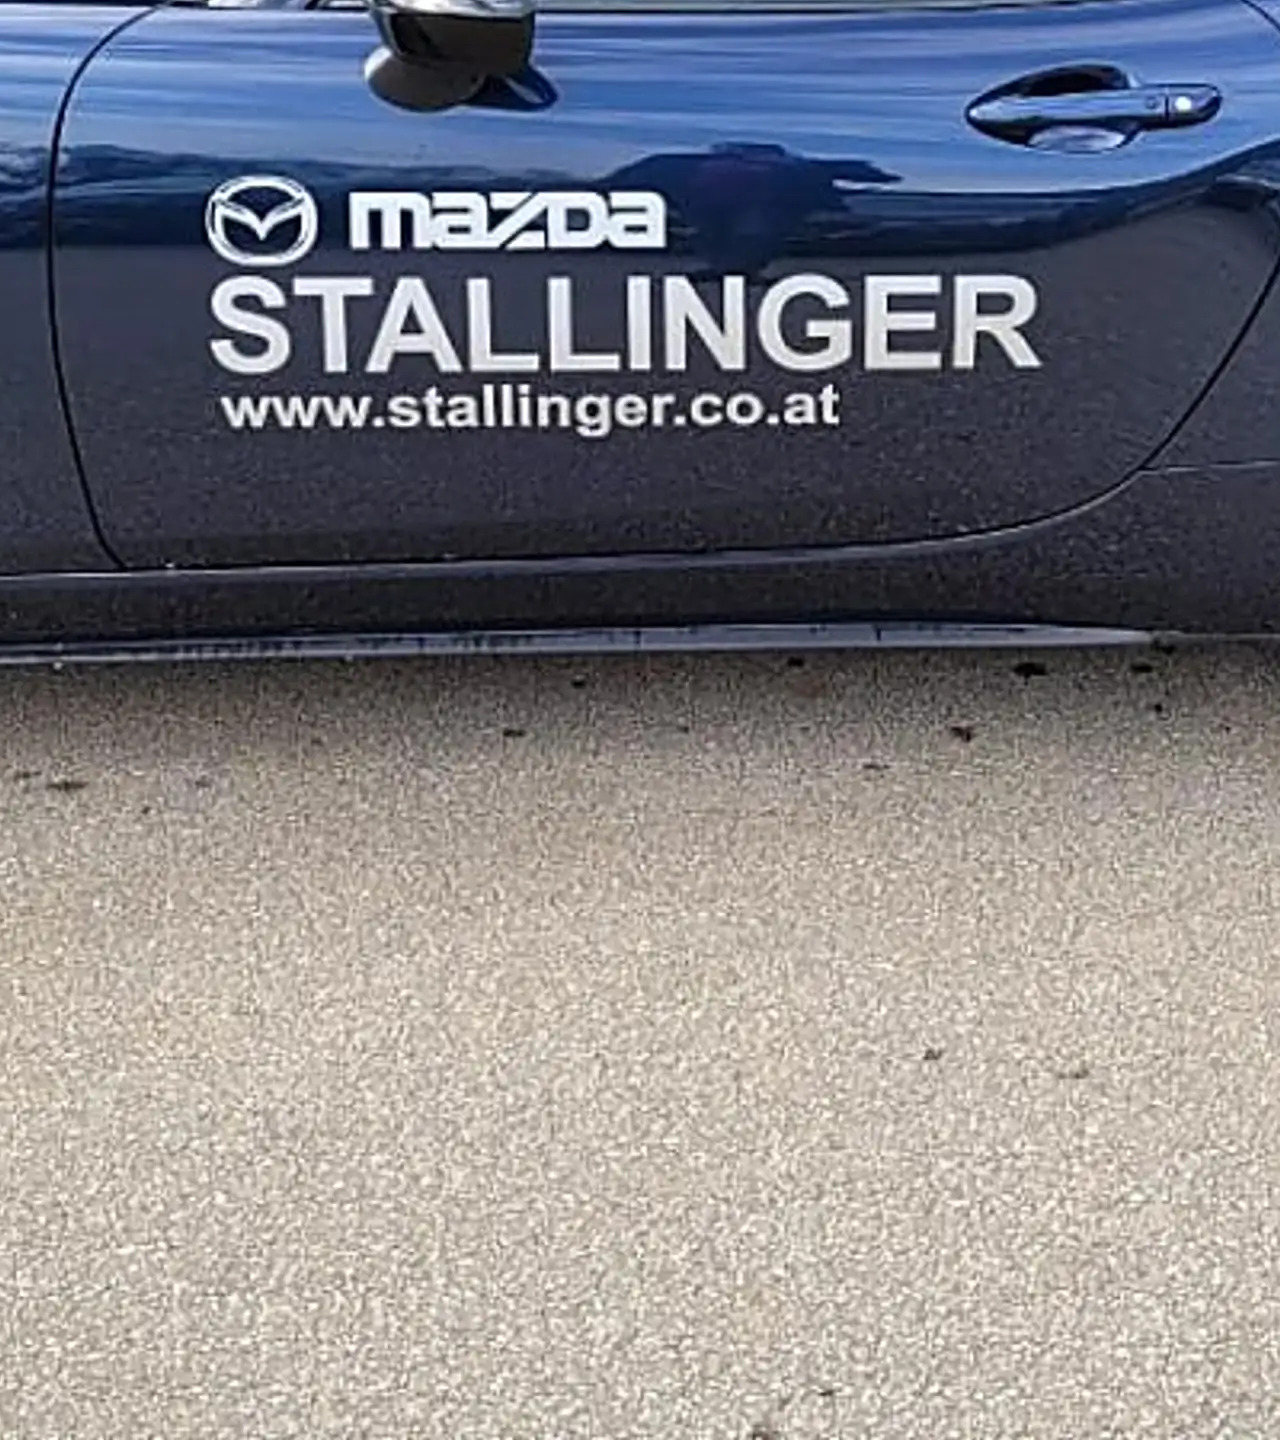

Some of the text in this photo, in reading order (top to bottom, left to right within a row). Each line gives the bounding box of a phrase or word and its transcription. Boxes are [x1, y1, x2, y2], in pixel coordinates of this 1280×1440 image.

[350, 191, 666, 250] mazda
[210, 274, 1041, 374] STALLINGER
[220, 383, 840, 437] www.stallinger.co.at
